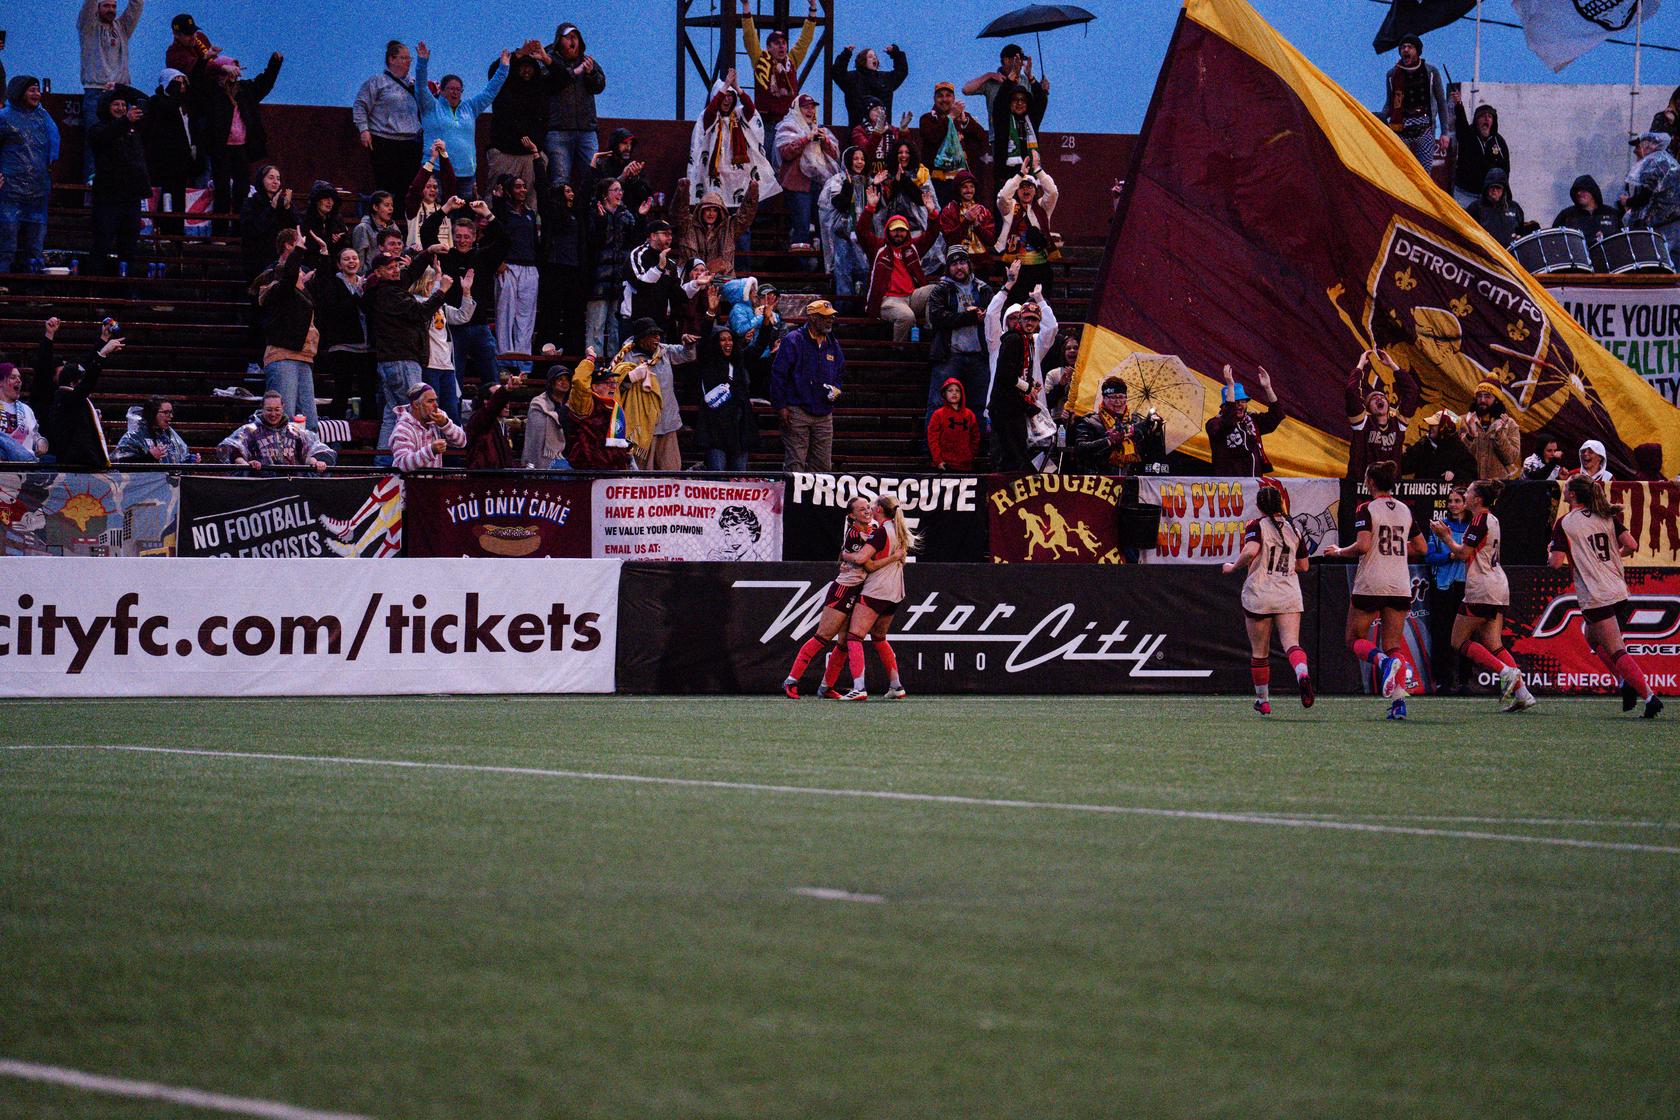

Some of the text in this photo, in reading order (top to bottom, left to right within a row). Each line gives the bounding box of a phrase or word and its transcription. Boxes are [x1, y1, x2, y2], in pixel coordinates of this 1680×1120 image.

[1061, 135, 1076, 148] 28
[1395, 238, 1541, 322] DETROIT CITY FC
[1622, 304, 1680, 337] YOUR
[1596, 340, 1680, 375] EALTH
[605, 484, 769, 501] OFFENDED? CONCERNED?
[793, 472, 977, 512] PROSECUTE
[990, 474, 1122, 516] REFUGEES
[1160, 482, 1244, 519] NO PYRO
[1403, 483, 1437, 496] THINGS
[191, 501, 316, 550] NO FOOTBALL
[446, 497, 571, 525] YOU ONLY CAME
[605, 504, 717, 519] HAVE A COMPLAINT?
[604, 524, 704, 536] WE VALUE YOUR OPINION!
[1156, 522, 1182, 558] NO
[1379, 525, 1405, 556] 85
[605, 543, 661, 555] EMAIL US AT:
[1267, 545, 1290, 576] 14
[1587, 533, 1611, 562] 19
[731, 581, 1213, 677] Mtor City
[1478, 672, 1552, 686] OFIAL
[1643, 672, 1677, 687] INK
